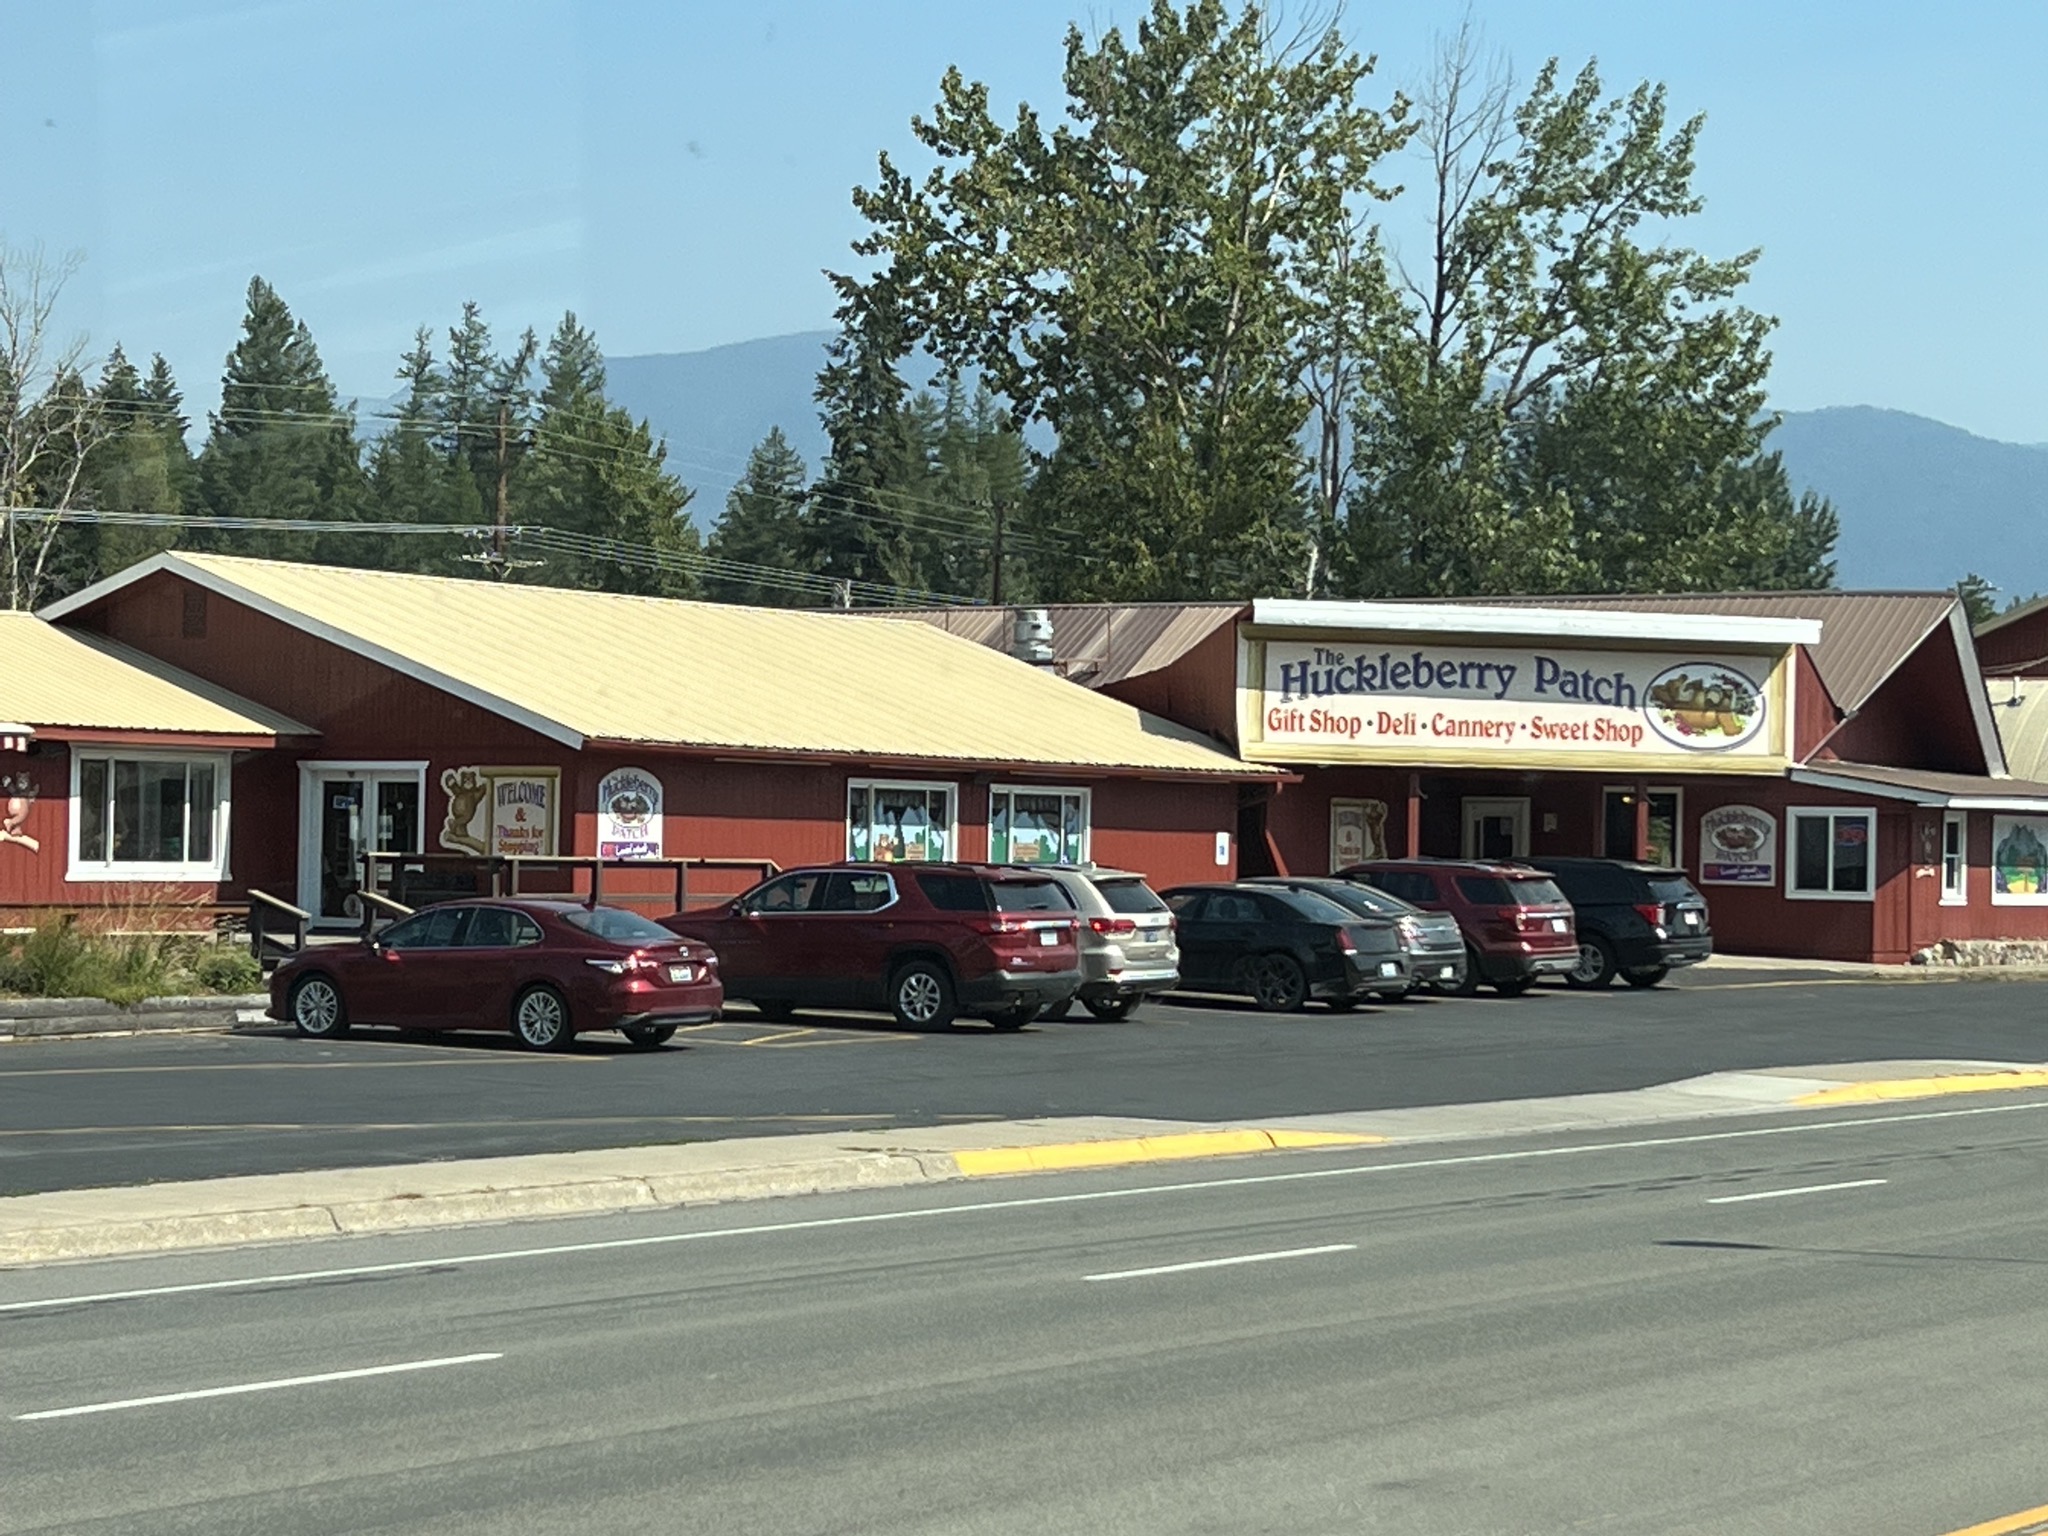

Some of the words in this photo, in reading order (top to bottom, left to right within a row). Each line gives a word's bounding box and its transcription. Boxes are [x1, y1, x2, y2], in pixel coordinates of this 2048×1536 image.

[1314, 648, 1344, 666] The
[1280, 652, 1518, 704] Huckleberry
[1534, 656, 1638, 712] Patch
[1268, 707, 1305, 733] Gift
[1309, 709, 1362, 739] Shop
[1376, 711, 1417, 736] Deli
[1432, 713, 1516, 744] Cannery
[1530, 715, 1589, 742] Sweet
[1593, 717, 1644, 747] Shop
[496, 780, 546, 809] WELCOME
[515, 806, 527, 822] &
